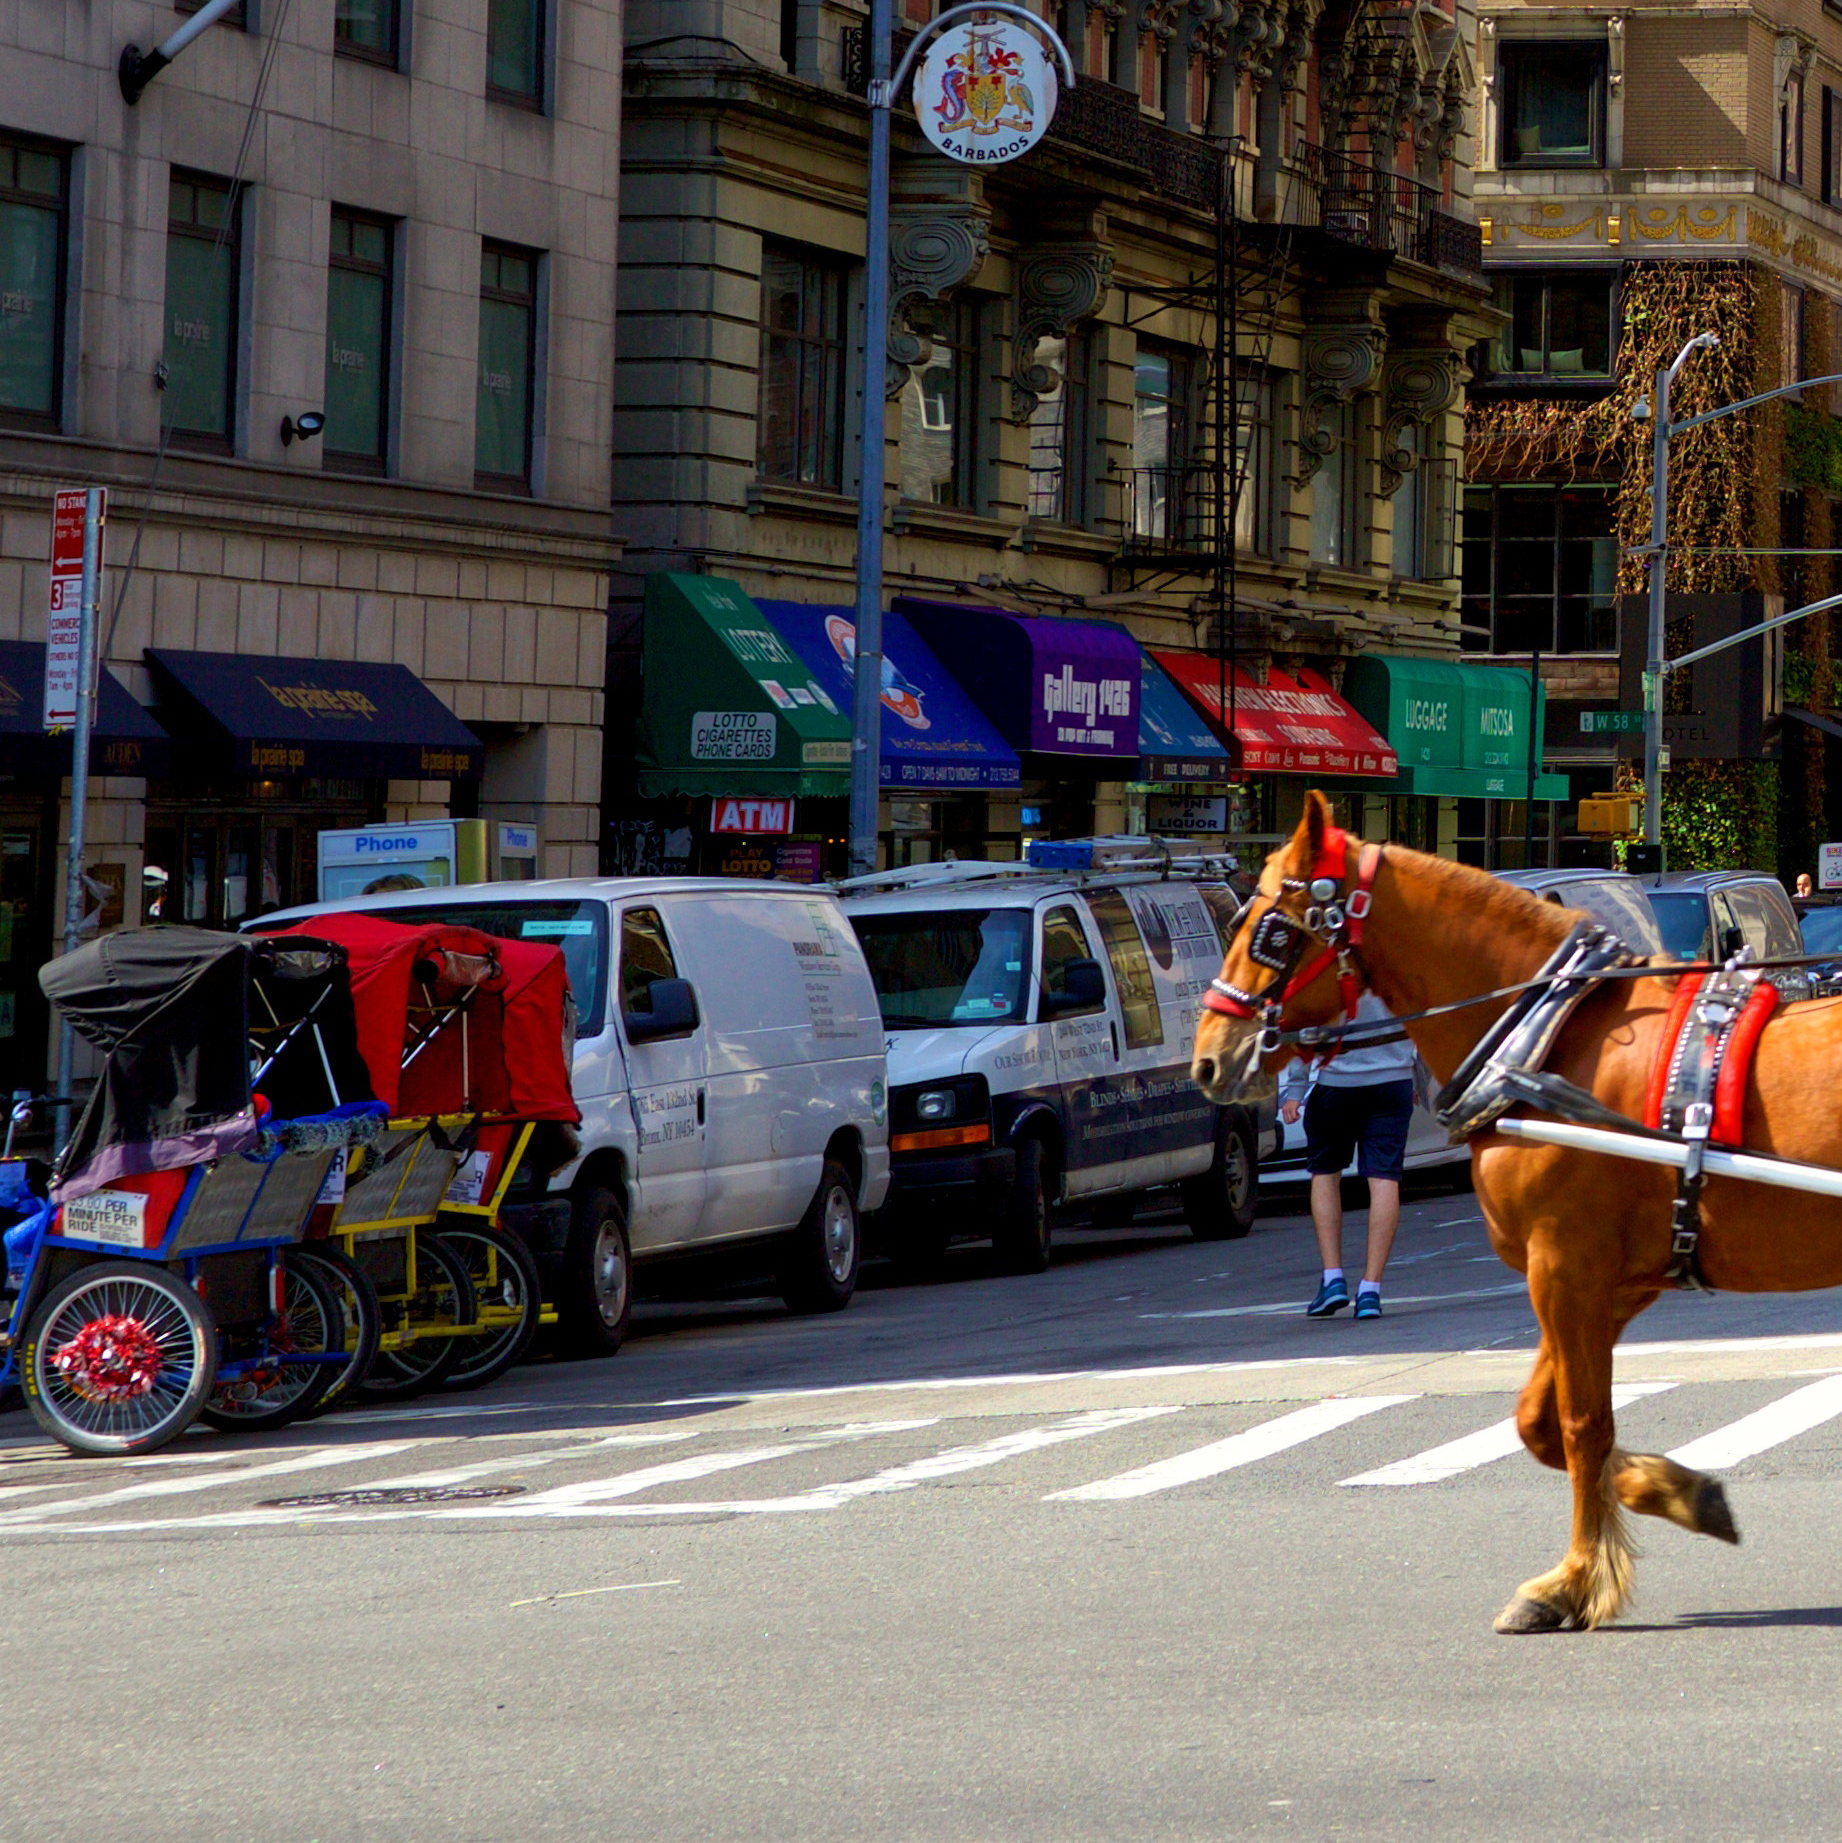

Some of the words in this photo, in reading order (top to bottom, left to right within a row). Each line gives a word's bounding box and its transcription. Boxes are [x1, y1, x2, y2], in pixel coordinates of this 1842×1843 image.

[942, 136, 1029, 160] BARBADOS
[57, 497, 67, 510] NO
[68, 496, 87, 510] STAND
[52, 583, 62, 608] 3
[52, 618, 80, 629] COMMERC
[720, 628, 793, 664] LOTTERY
[1044, 664, 1097, 727] Gallery
[713, 714, 758, 727] LOTTO
[1405, 699, 1449, 731] LUGGAGE
[1480, 707, 1515, 737] MITSOSA
[1596, 715, 1609, 729] W
[1614, 714, 1629, 729] 58
[697, 729, 772, 743] CIGARETTES
[1663, 727, 1710, 741] OTEL
[695, 744, 732, 758] PHONE
[735, 744, 772, 758] CARDS
[1163, 763, 1178, 775] FREE
[1181, 763, 1211, 776] DELIVERY
[1168, 799, 1211, 810] WINE
[718, 800, 786, 831] ATM
[1157, 818, 1218, 829] LIQUOR
[356, 836, 418, 852] Phone
[507, 829, 528, 848] Phone
[730, 847, 765, 858] PLAY
[721, 859, 773, 873] LOTTO
[105, 1199, 128, 1214] PER
[68, 1208, 113, 1225] MINUTE
[113, 1213, 139, 1229] PER
[68, 1219, 98, 1234] RIDE
